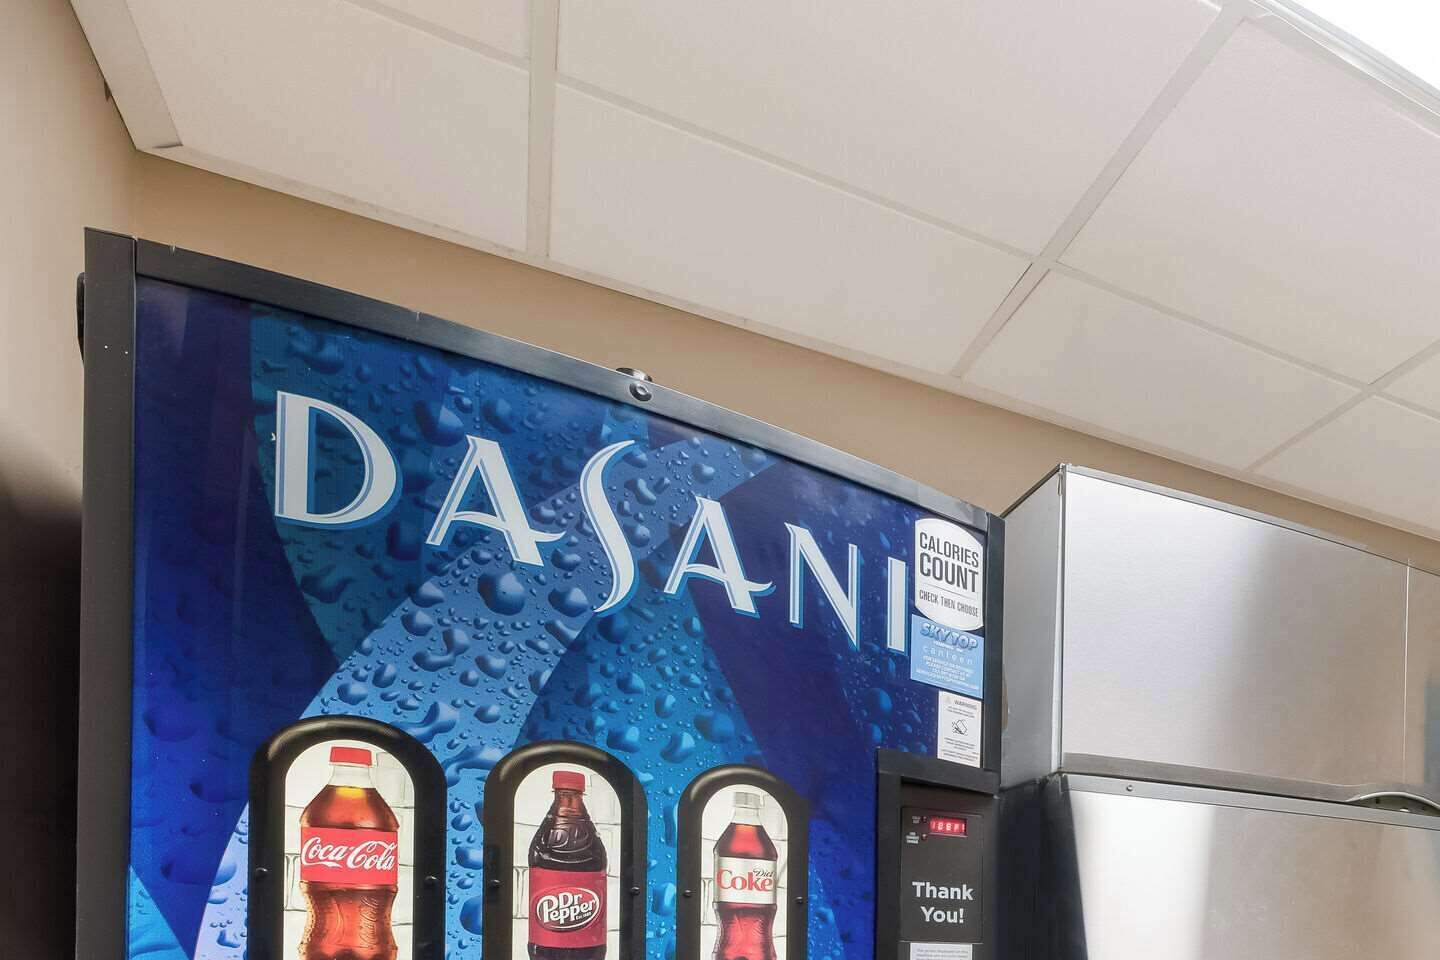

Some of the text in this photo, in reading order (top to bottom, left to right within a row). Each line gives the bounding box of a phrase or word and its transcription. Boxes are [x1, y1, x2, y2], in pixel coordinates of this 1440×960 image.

[275, 390, 908, 656] DASANI
[920, 532, 979, 568] CALORIES
[920, 553, 979, 592] COUNT
[919, 589, 979, 617] CHECK THEN CHOOSE
[301, 836, 397, 870] Coca-Cola
[716, 869, 774, 892] Coke
[752, 867, 774, 878] Diet
[558, 892, 582, 909] Dr
[911, 881, 974, 901] Thank
[537, 895, 596, 925] Pepper
[920, 906, 964, 924] You!
